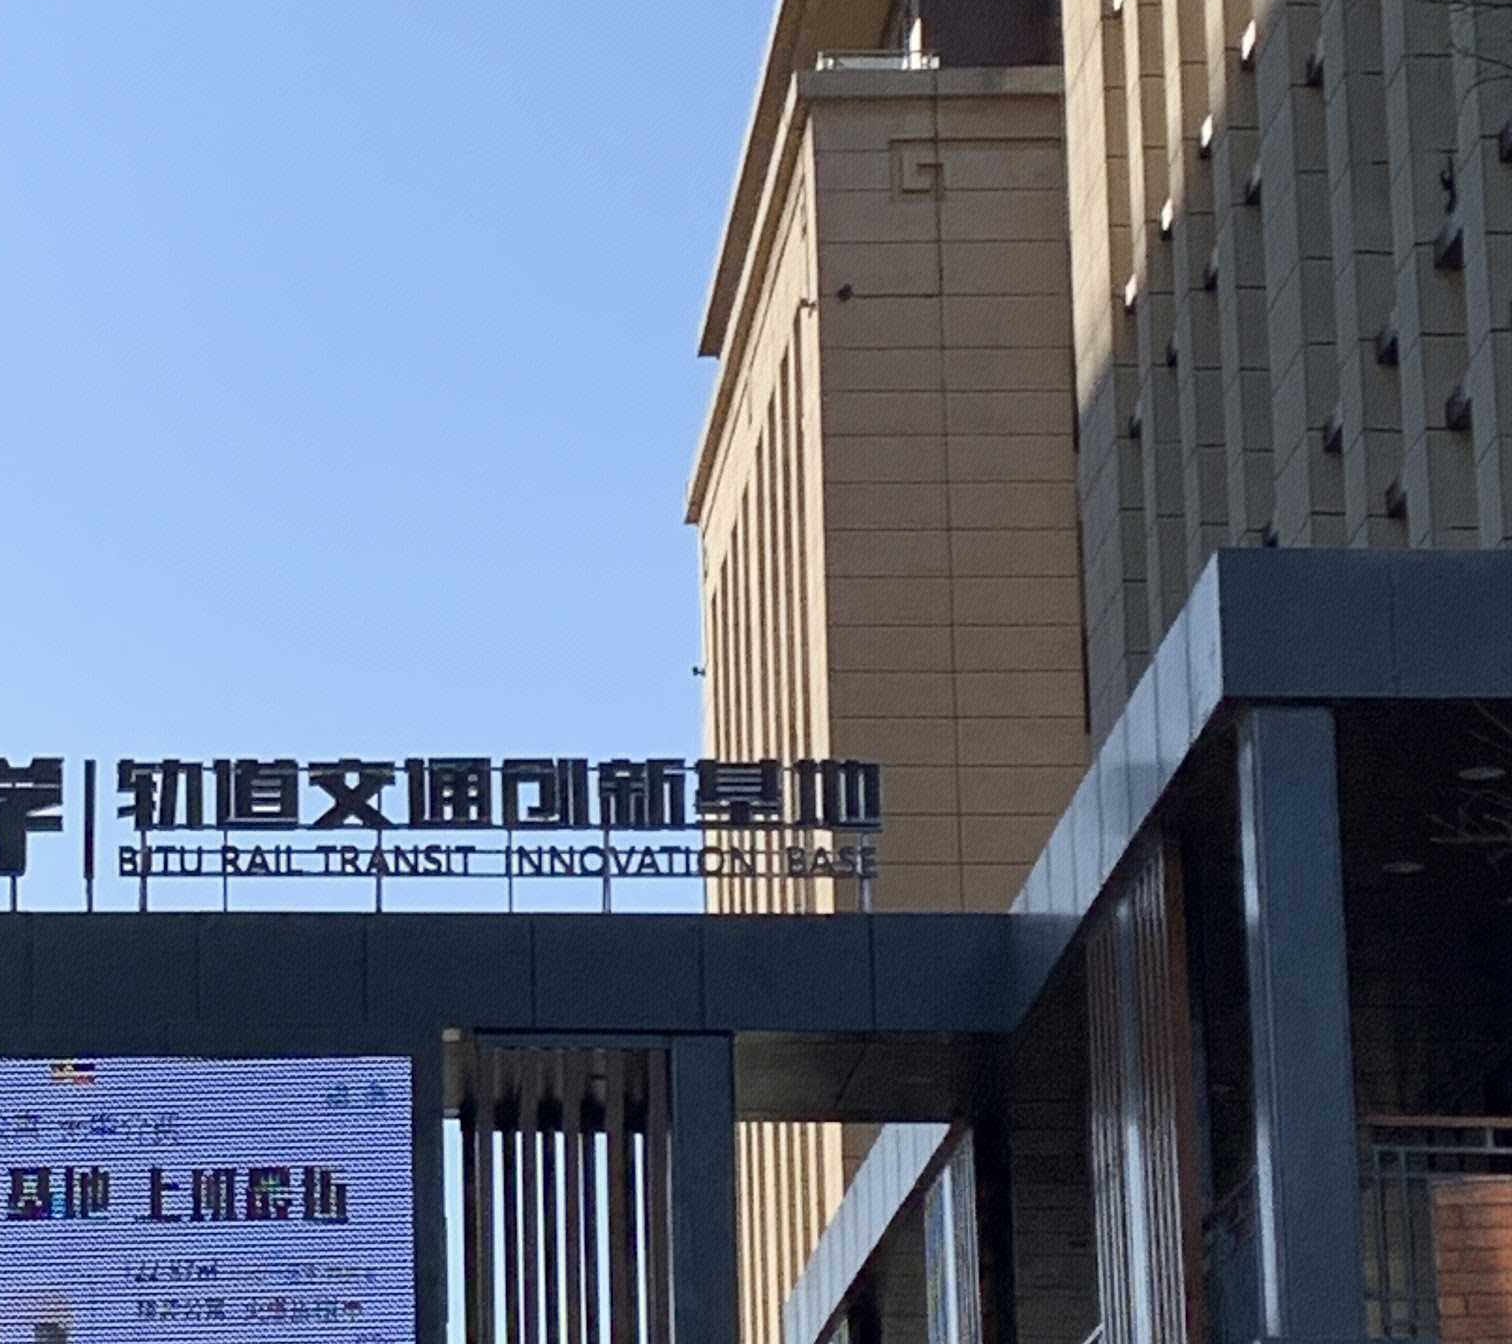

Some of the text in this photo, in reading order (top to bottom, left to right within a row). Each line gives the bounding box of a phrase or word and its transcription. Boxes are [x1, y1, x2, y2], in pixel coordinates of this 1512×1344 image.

[117, 757, 882, 832] 轨道交通创新基地
[220, 845, 303, 876] RAIL
[315, 845, 477, 877] TRANSIT
[504, 845, 756, 877] INNOVATION
[786, 845, 878, 879] BASE
